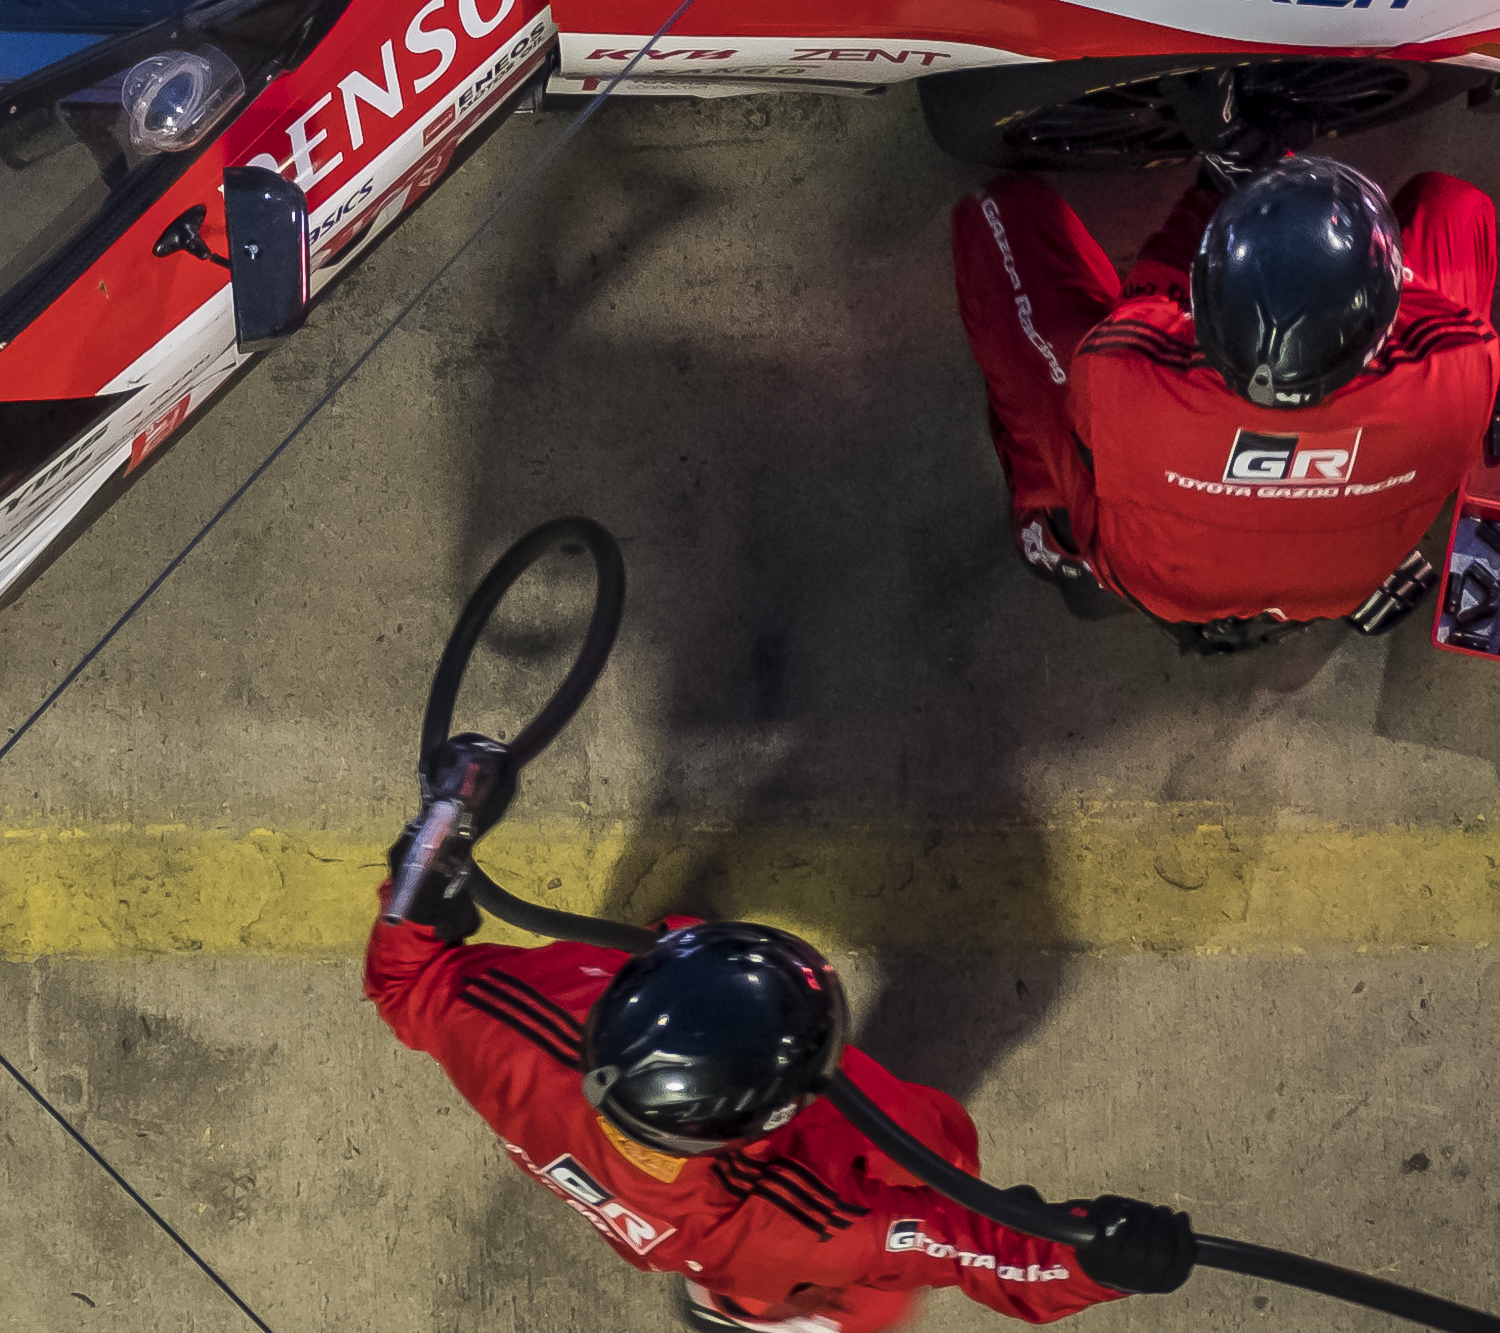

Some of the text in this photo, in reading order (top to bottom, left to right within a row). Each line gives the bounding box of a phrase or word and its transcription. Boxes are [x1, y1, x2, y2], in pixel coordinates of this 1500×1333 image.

[457, 21, 547, 108] ENEOS
[789, 47, 953, 67] ZENT
[1232, 449, 1350, 479] GR
[1164, 469, 1418, 499] TOYOTA GAZOO Racing
